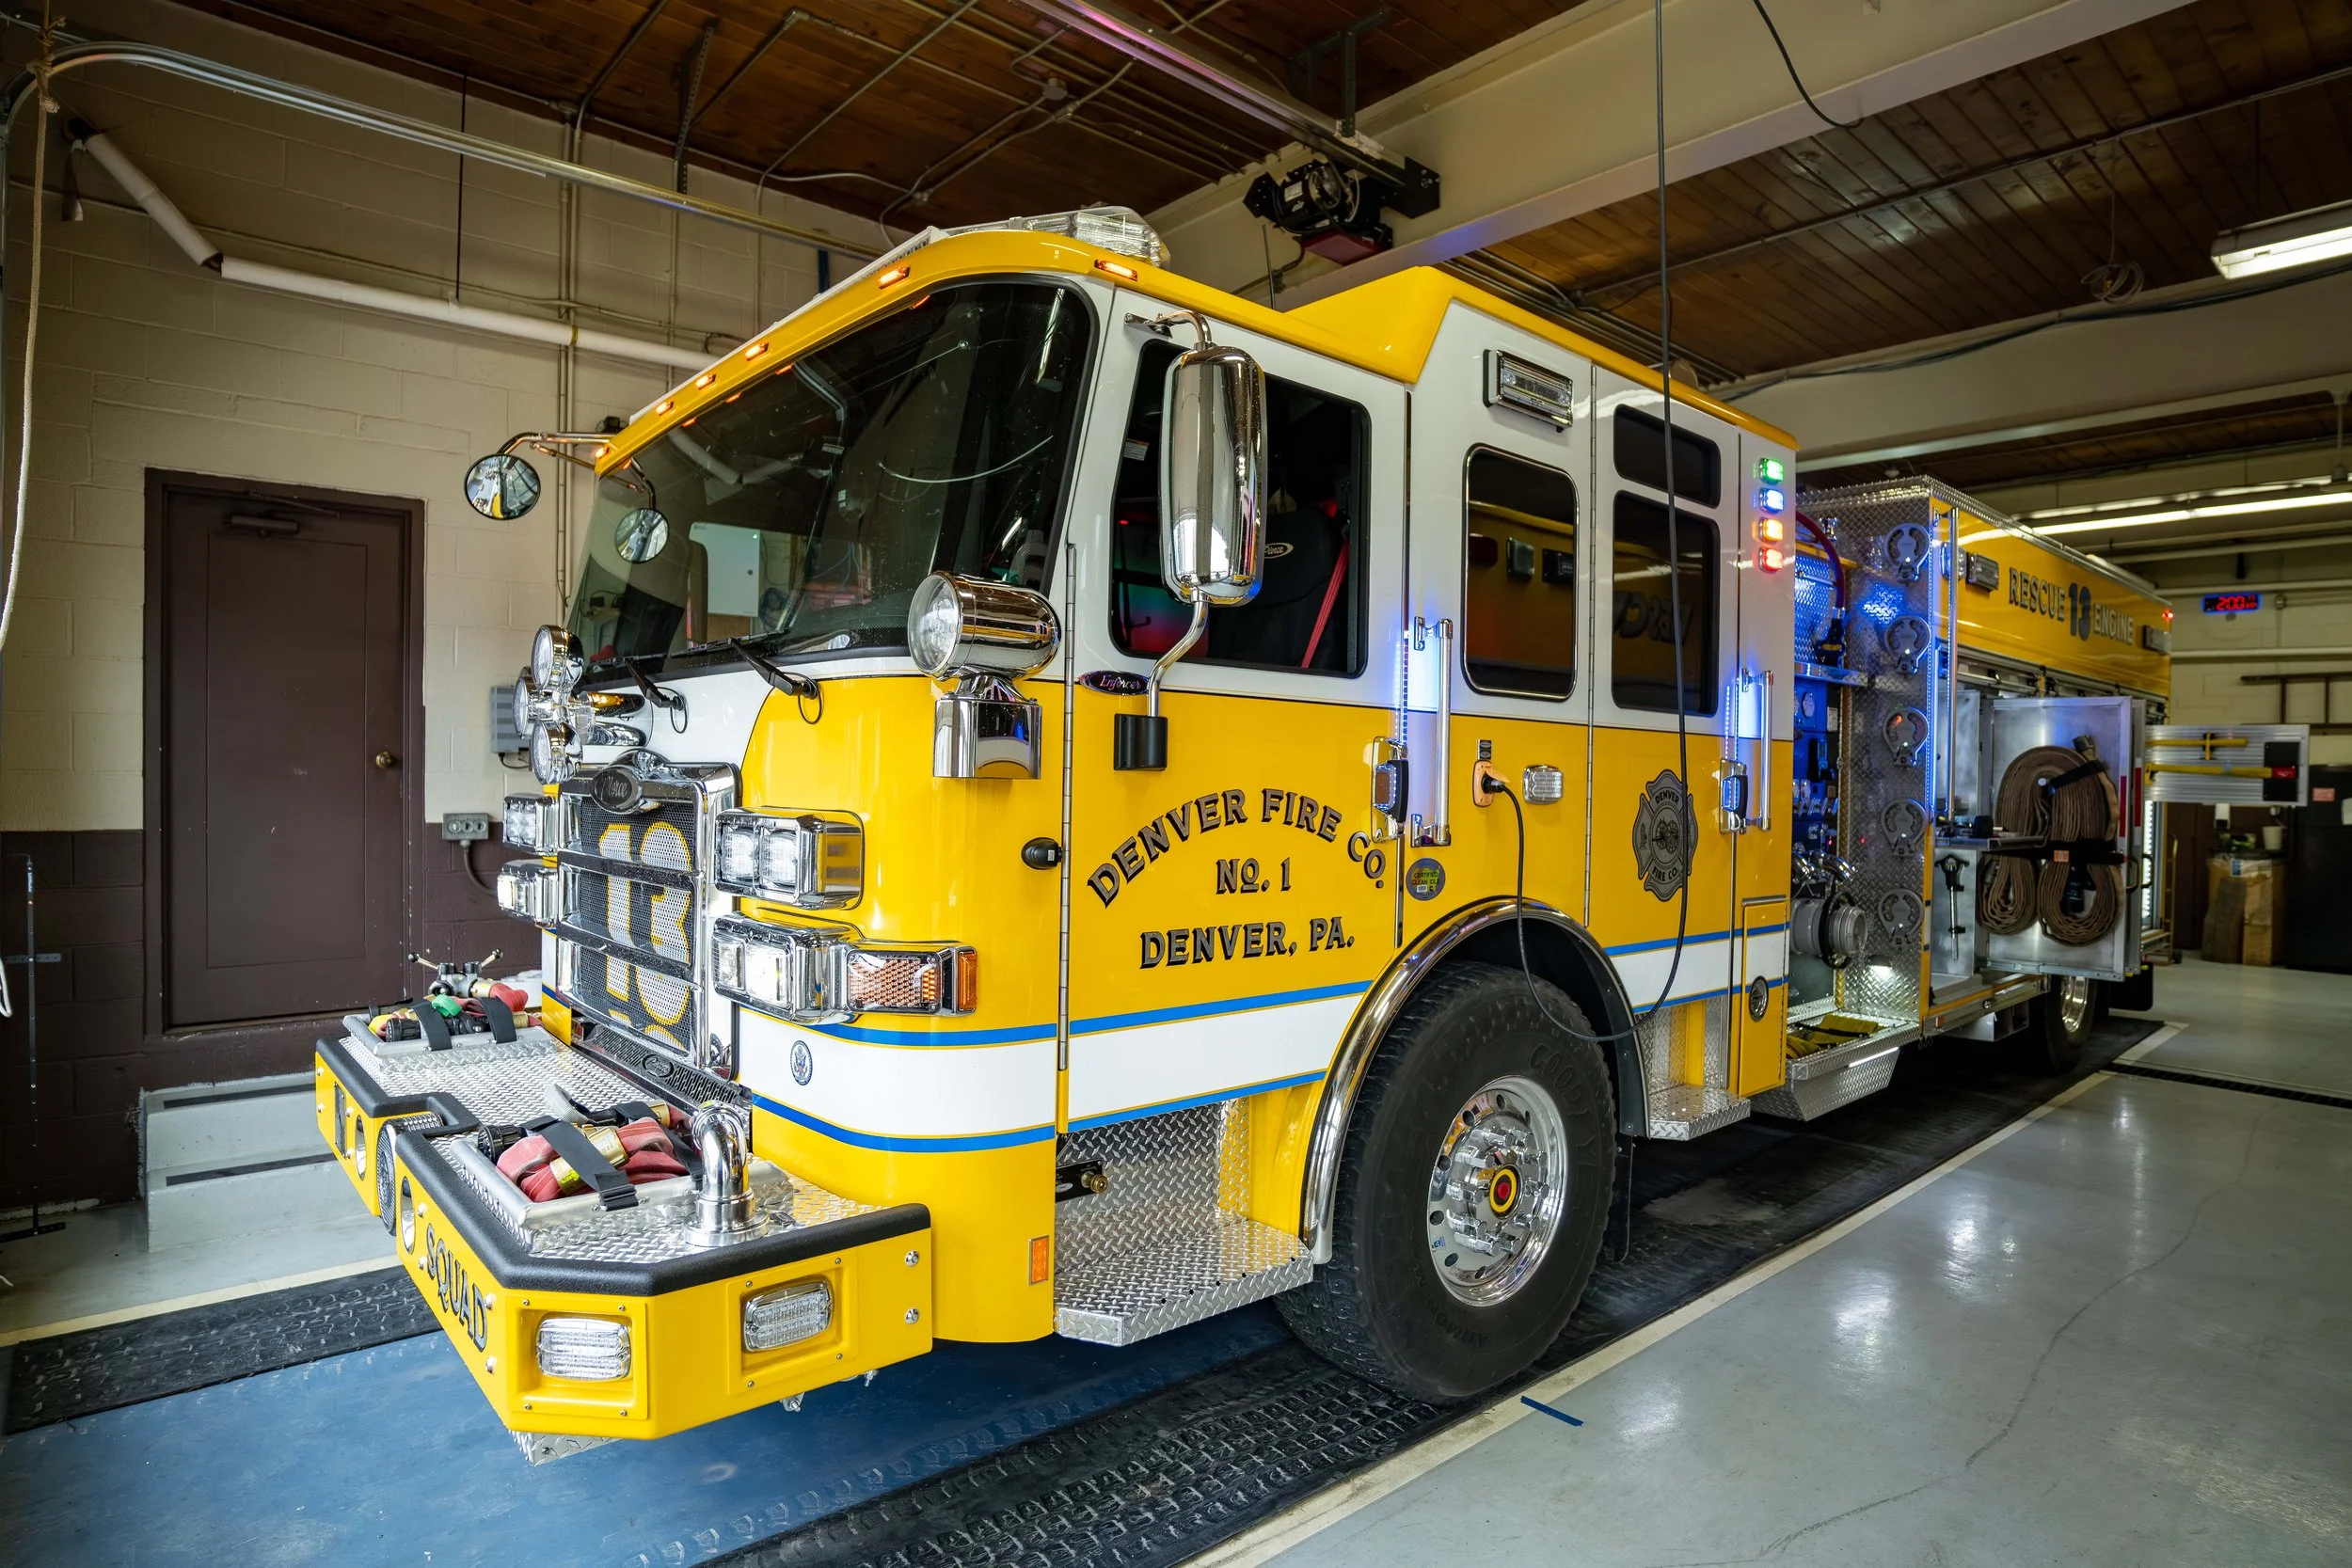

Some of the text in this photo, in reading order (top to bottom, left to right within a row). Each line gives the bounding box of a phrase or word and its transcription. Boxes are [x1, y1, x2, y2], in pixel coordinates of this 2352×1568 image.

[2009, 567, 2134, 644] RESCUE 13 ENGINE
[1100, 674, 1142, 690] Enforcer
[1655, 790, 1679, 805] DENVER
[1088, 788, 1387, 909] DENVER FIRE CO.
[1279, 857, 1292, 893] 1
[1652, 865, 1666, 881] FIRE
[598, 821, 691, 1026] 13
[1139, 916, 1355, 969] DENVER, PA.
[426, 1223, 488, 1353] SQUAD
